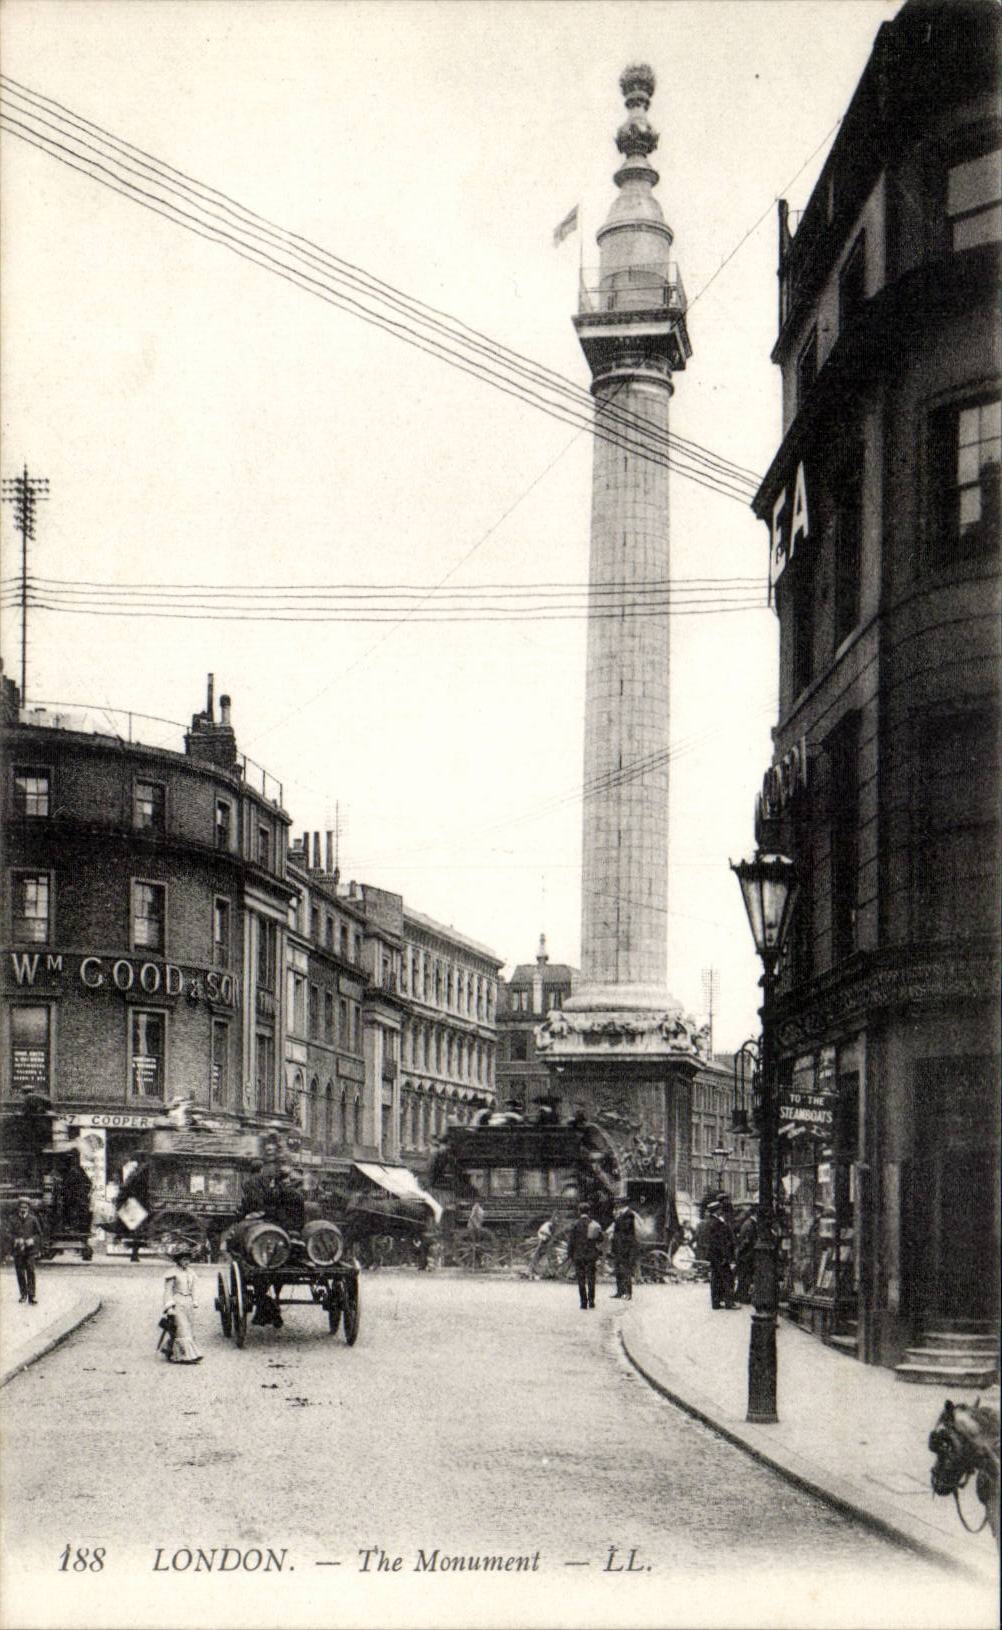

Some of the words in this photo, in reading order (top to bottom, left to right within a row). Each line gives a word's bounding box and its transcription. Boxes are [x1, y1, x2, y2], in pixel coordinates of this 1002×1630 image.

[80, 956, 184, 995] GOOD
[790, 1094, 801, 1104] TO
[808, 1095, 825, 1106] THE
[92, 1115, 149, 1127] COOPER
[780, 1106, 833, 1123] STEAMBOATS
